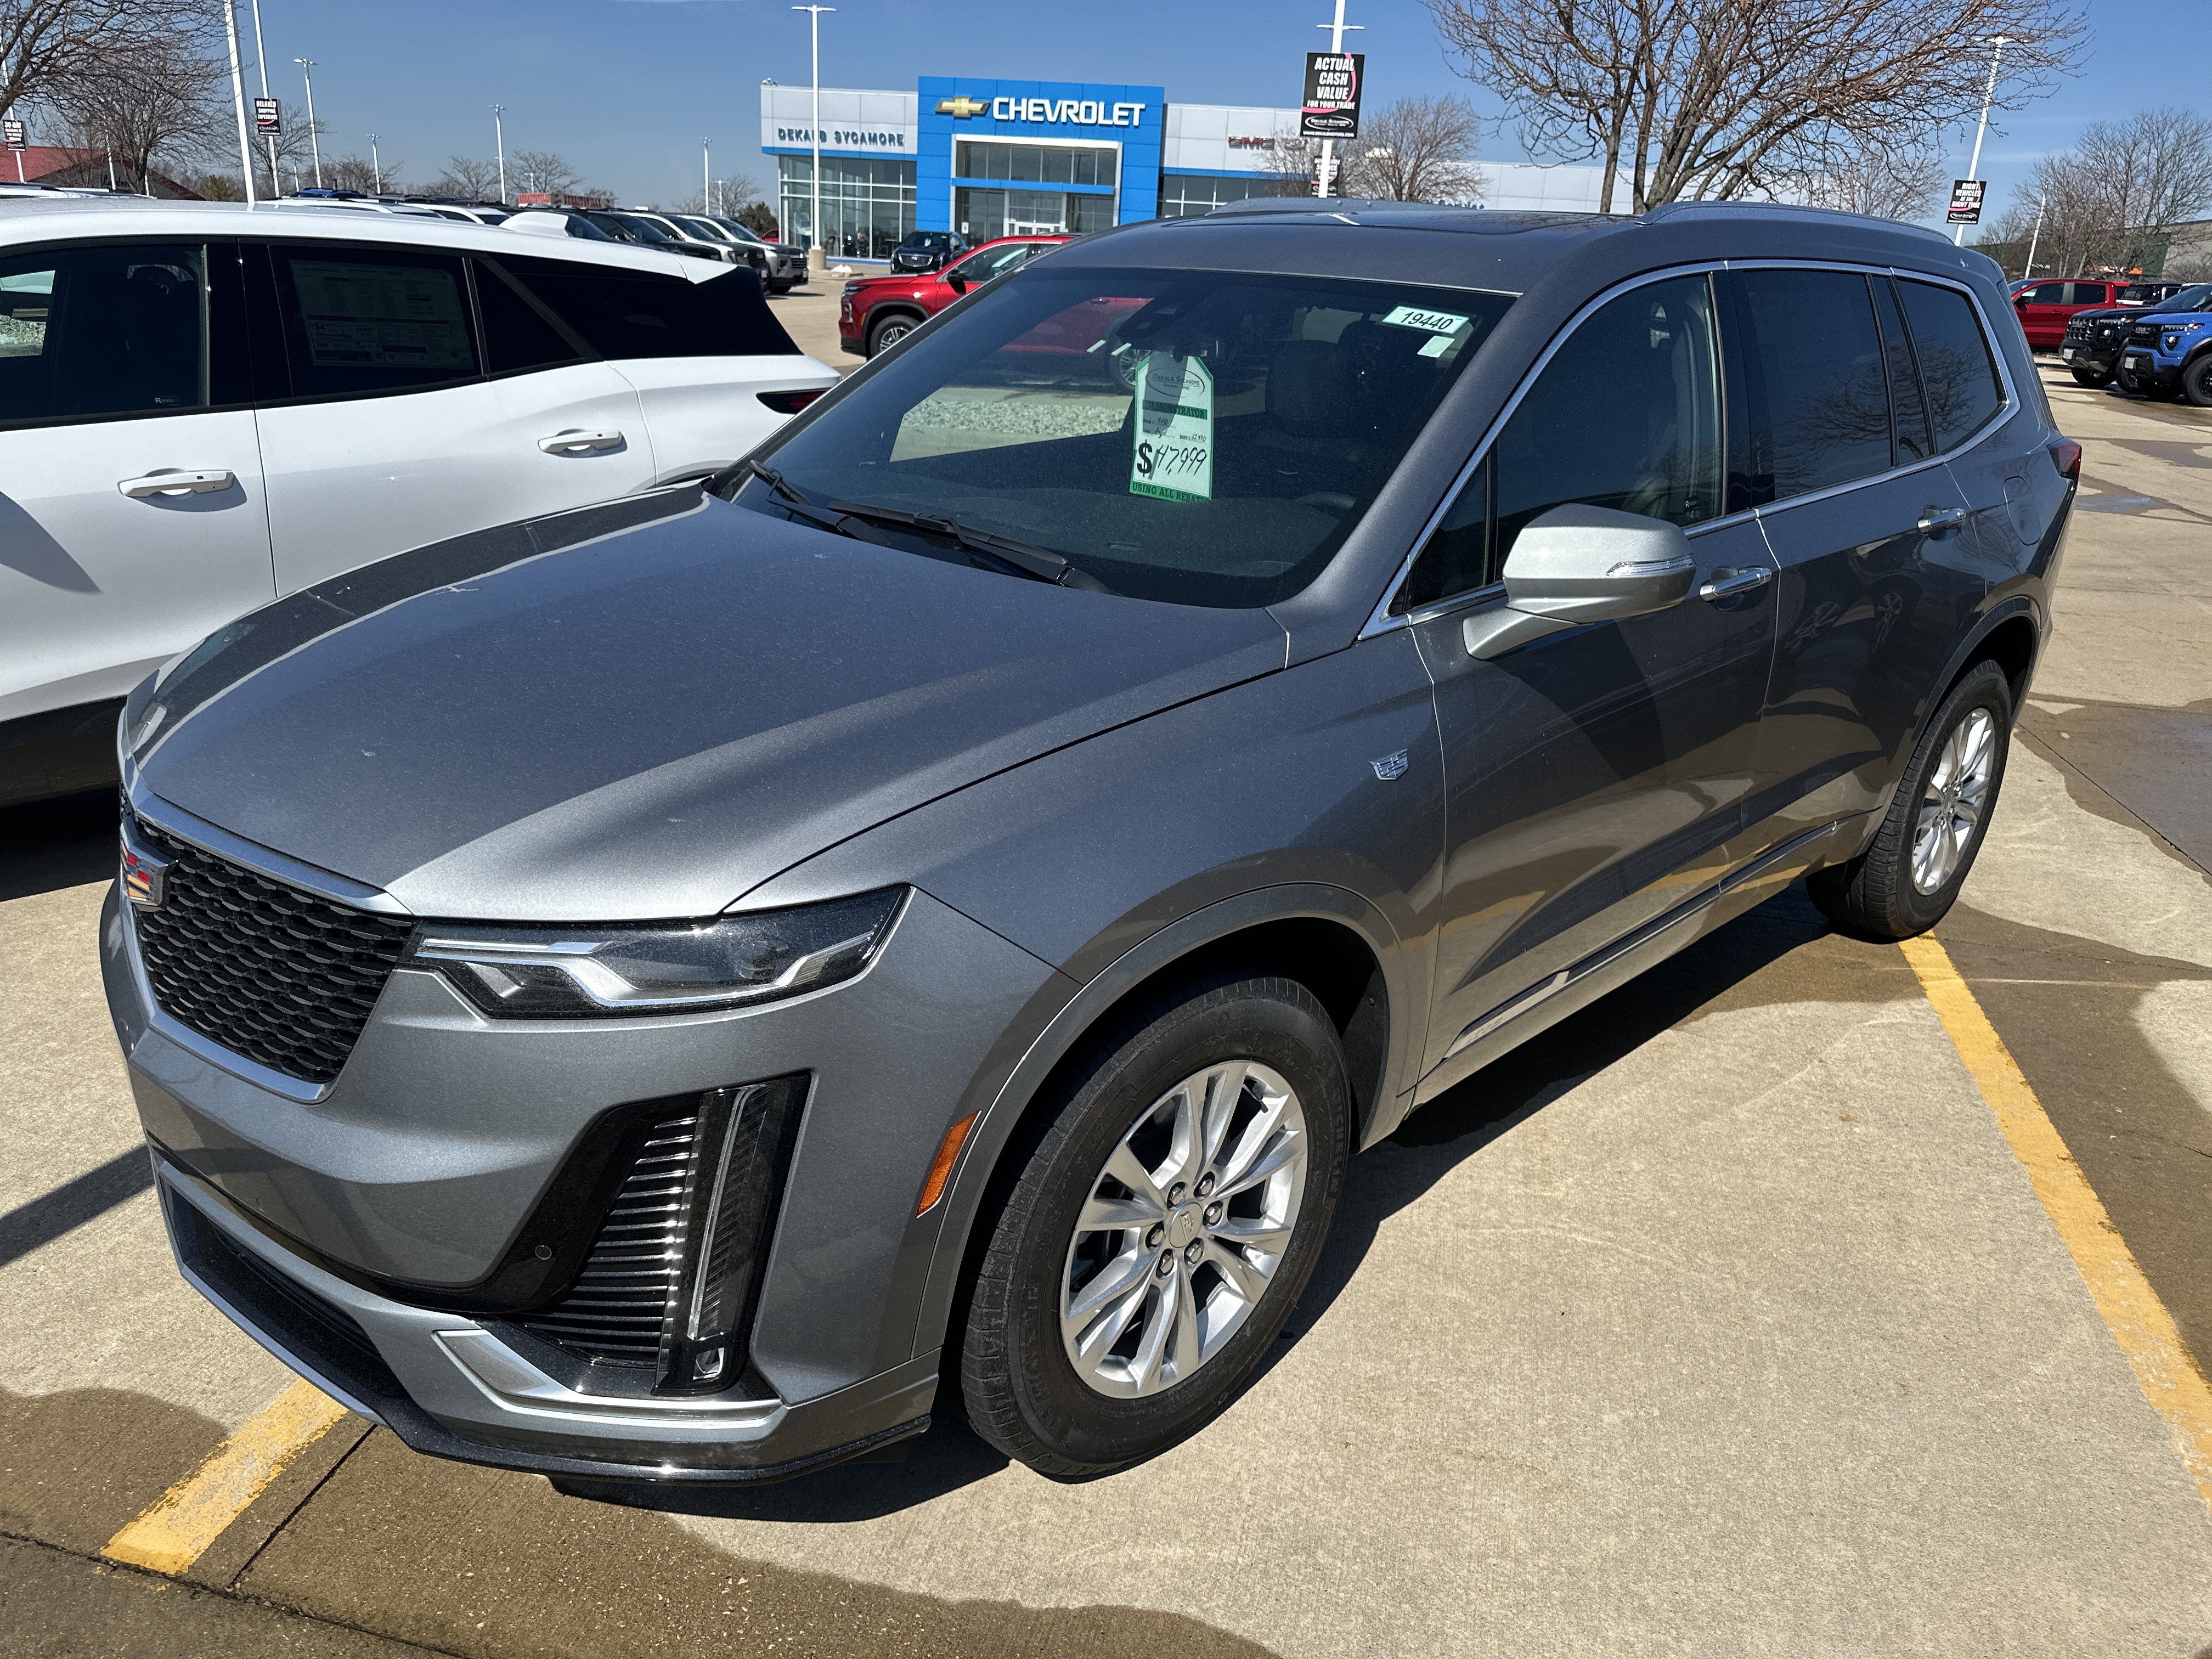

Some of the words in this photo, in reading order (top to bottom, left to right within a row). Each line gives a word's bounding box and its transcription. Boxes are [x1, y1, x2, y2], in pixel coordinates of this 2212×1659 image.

[1314, 57, 1355, 71] ACTUAL
[1319, 72, 1348, 85] CASH
[1317, 86, 1349, 100] VALUE
[1307, 99, 1318, 108] FOR
[1319, 100, 1335, 109] YOUR
[1336, 101, 1356, 110] TRADE
[993, 97, 1146, 127] CHEVROLET
[778, 128, 827, 144] DEKAB
[834, 131, 904, 147] SYCAMORE
[1228, 136, 1274, 149] GMC
[1400, 311, 1454, 330] 19440
[1176, 376, 1200, 386] SYCAMORE
[1145, 400, 1205, 419] DEMONSTRATOR
[1132, 483, 1157, 495] USING
[1159, 488, 1174, 499] ALL
